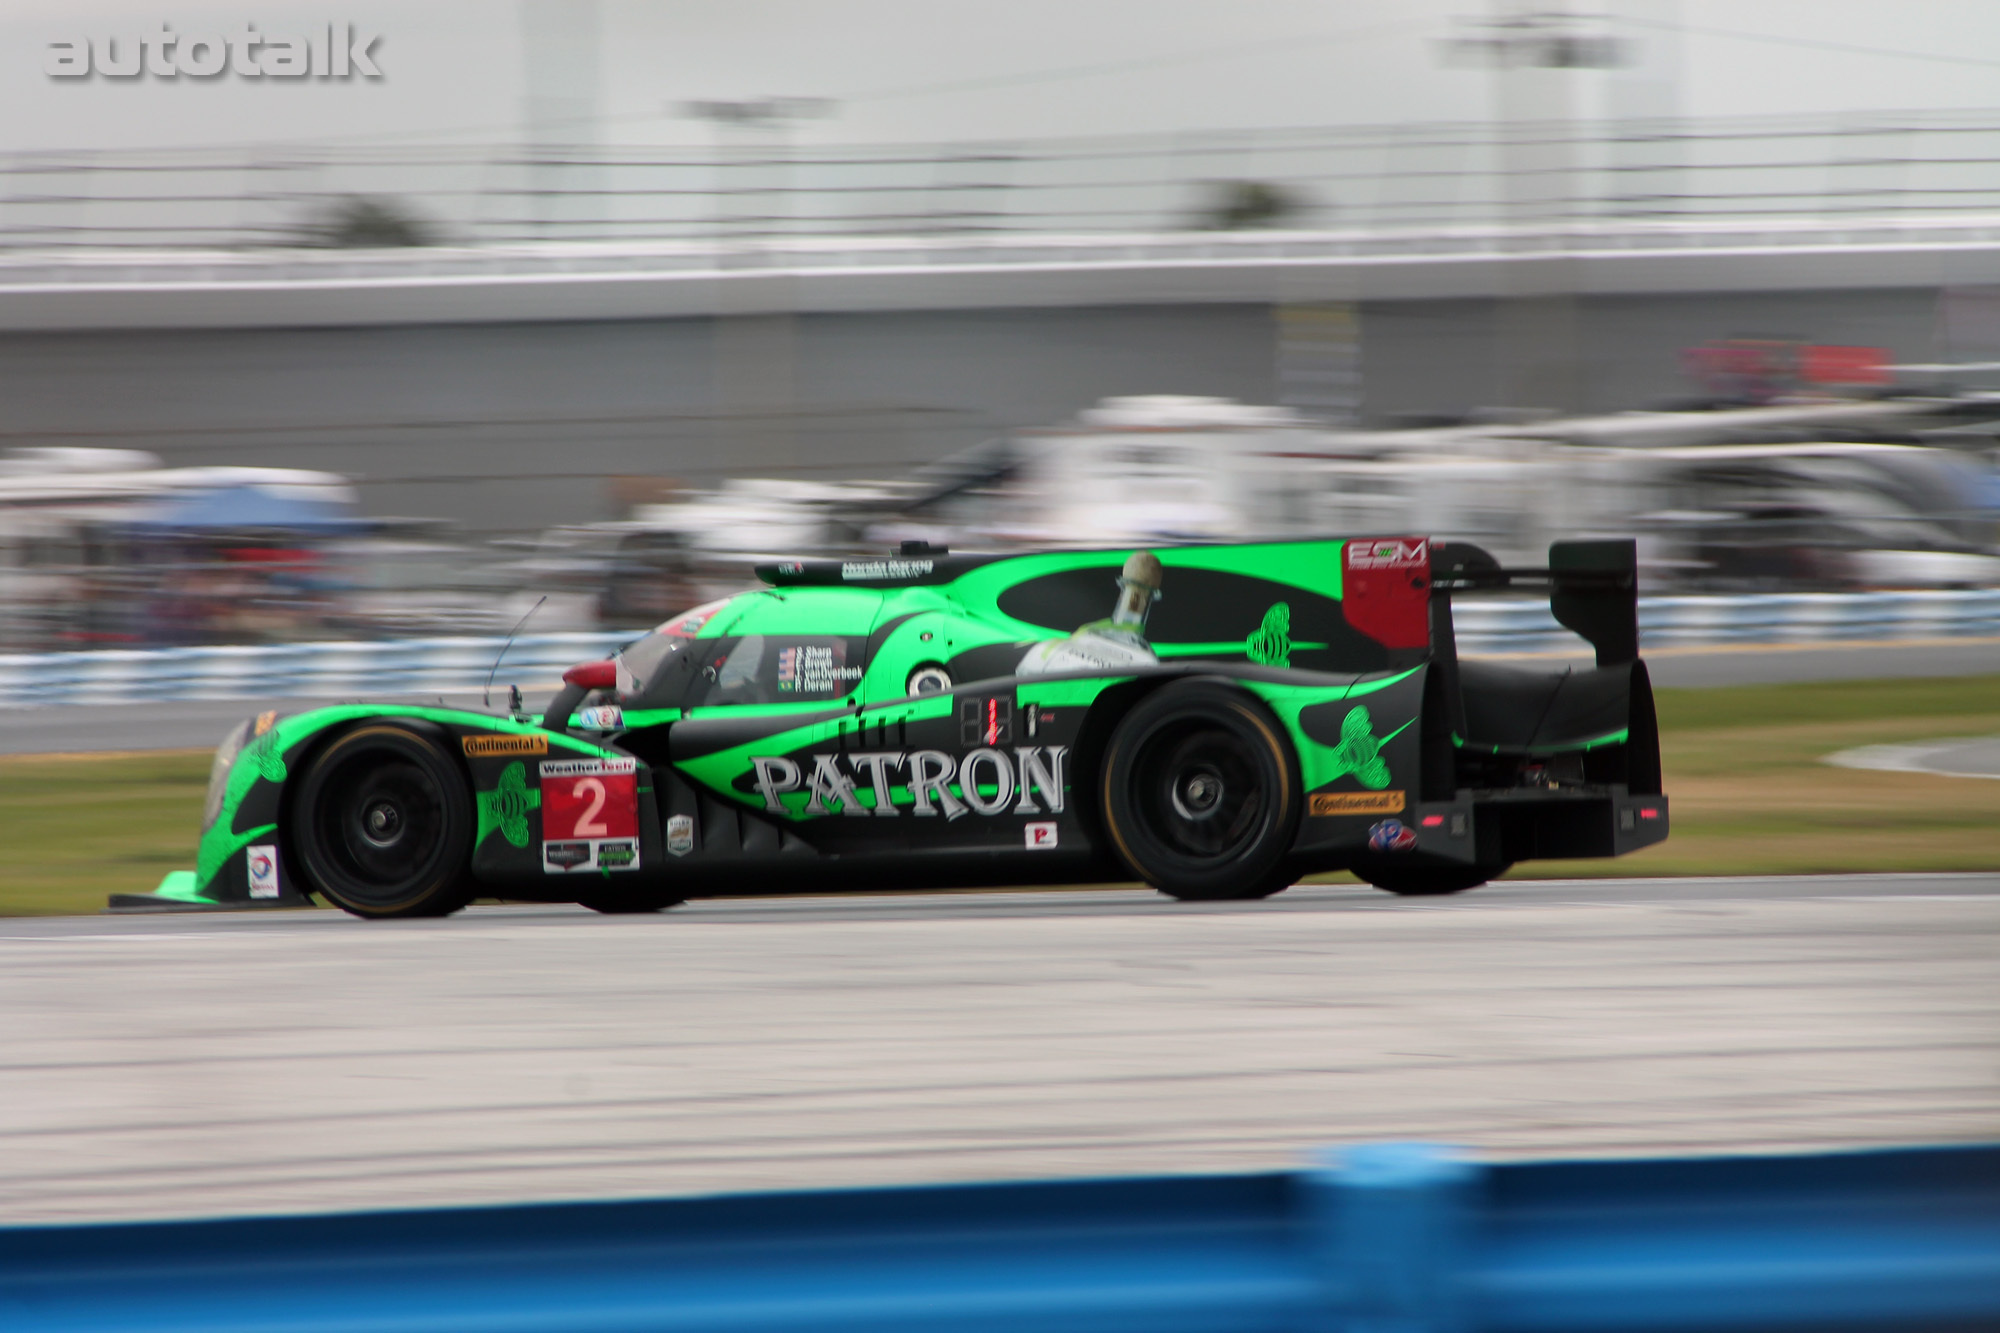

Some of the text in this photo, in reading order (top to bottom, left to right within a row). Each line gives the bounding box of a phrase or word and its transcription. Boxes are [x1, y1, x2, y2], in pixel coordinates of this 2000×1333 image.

[1348, 540, 1427, 562] ESM
[465, 737, 534, 753] Continental
[543, 761, 633, 773] WeatherTech
[572, 778, 608, 838] 2
